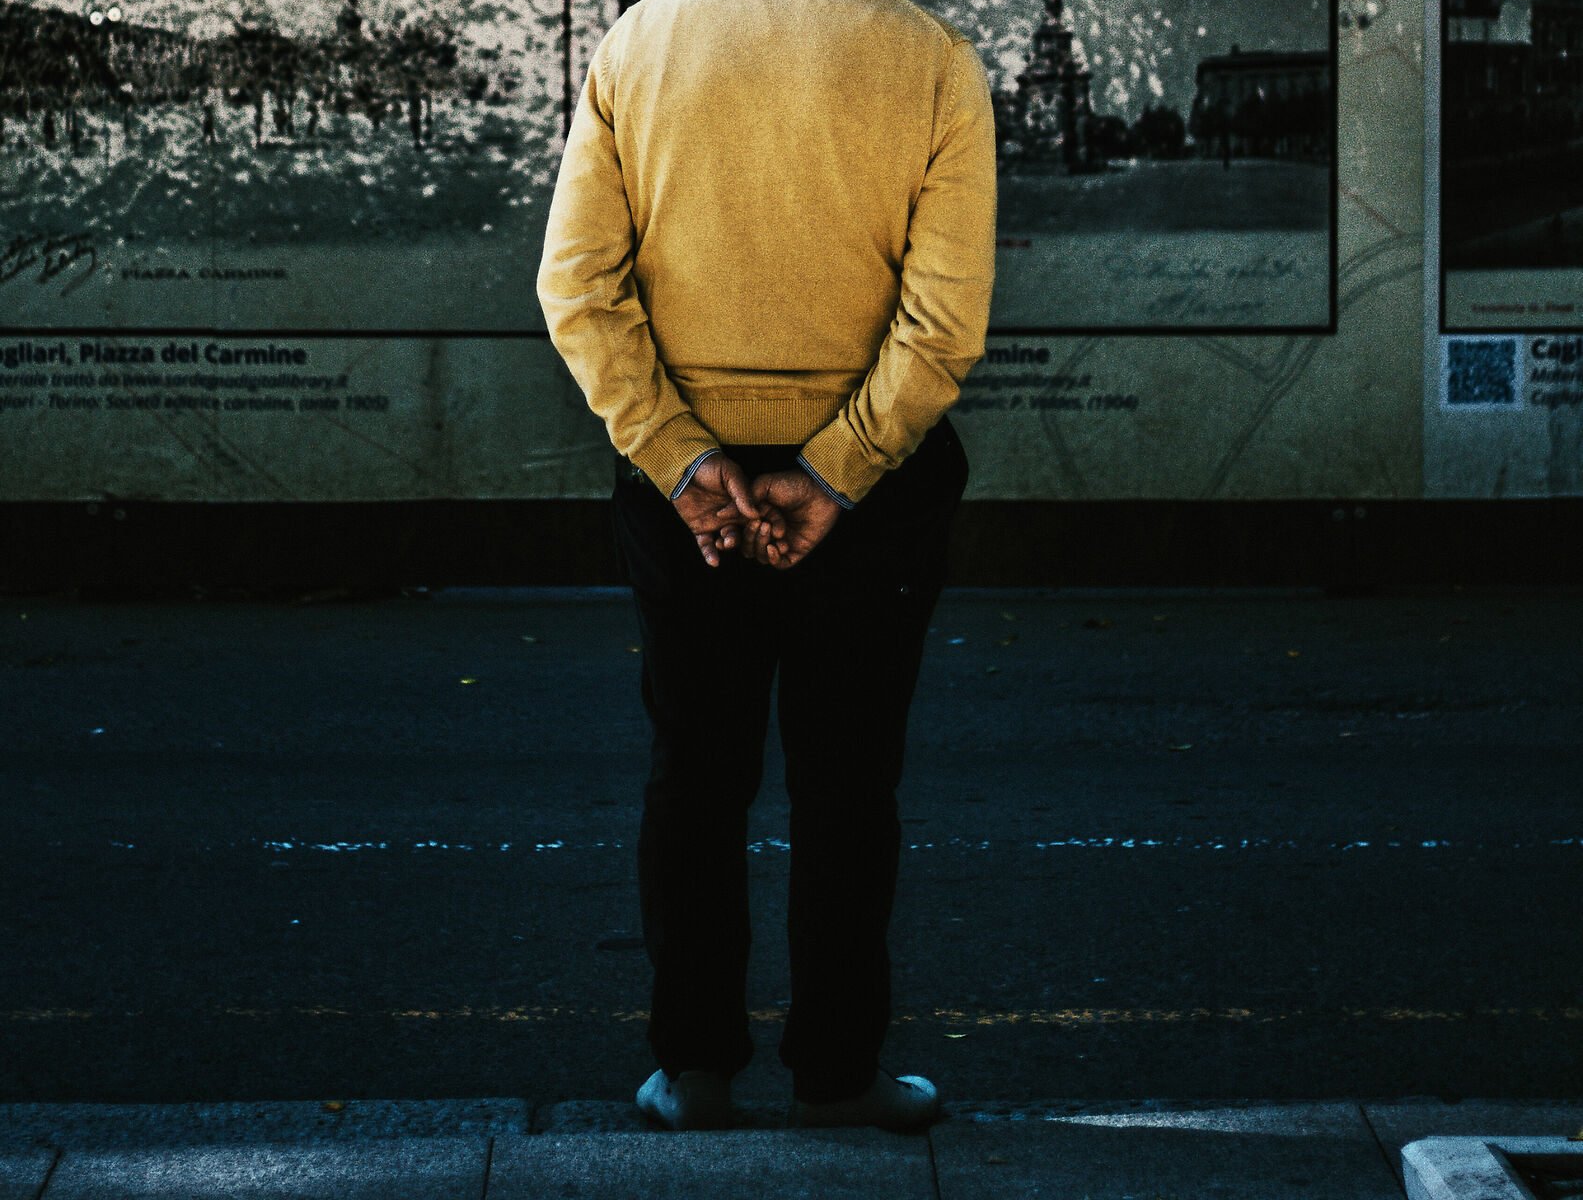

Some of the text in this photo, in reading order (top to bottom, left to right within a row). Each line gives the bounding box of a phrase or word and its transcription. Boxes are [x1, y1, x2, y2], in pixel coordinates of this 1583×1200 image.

[80, 344, 155, 364] Piazza
[161, 342, 198, 363] del
[205, 343, 306, 364] Carmine
